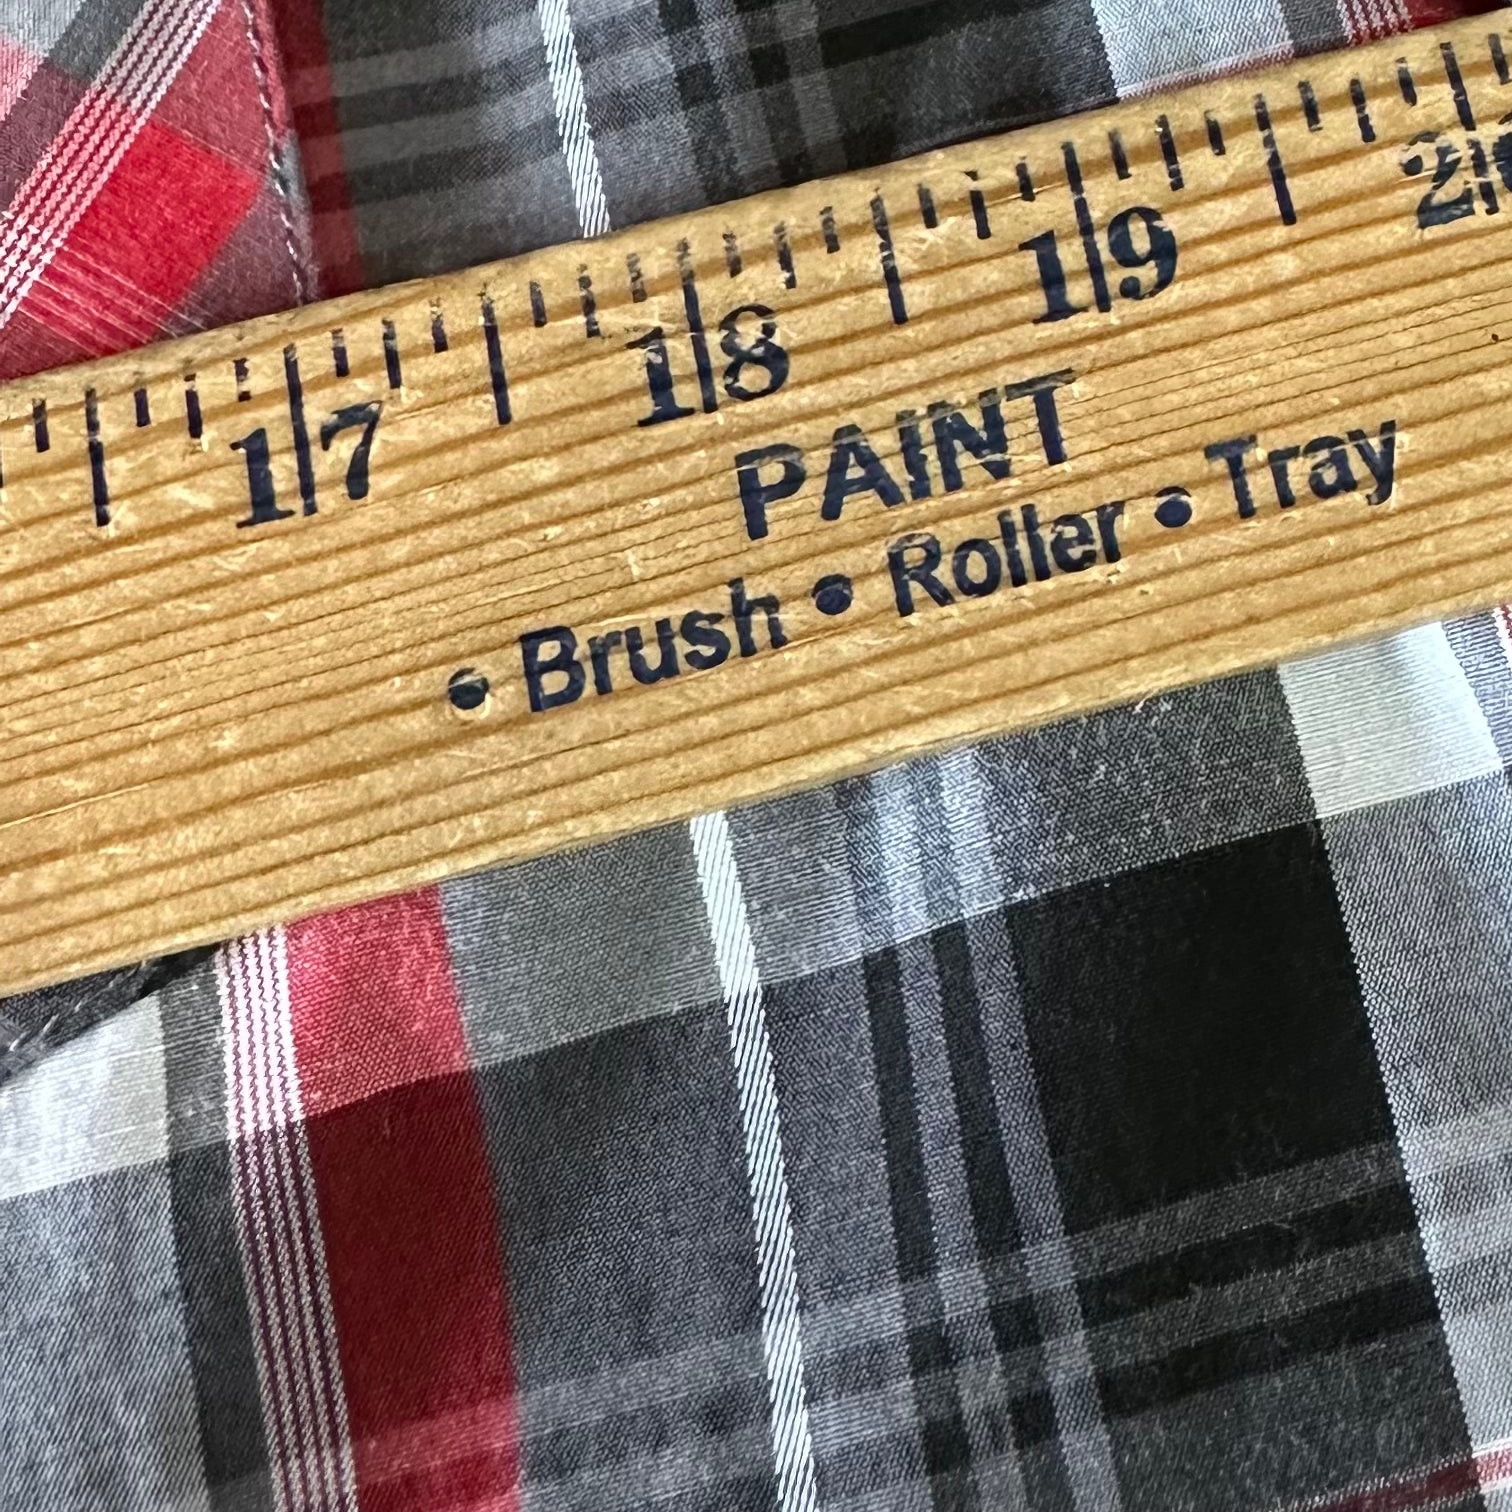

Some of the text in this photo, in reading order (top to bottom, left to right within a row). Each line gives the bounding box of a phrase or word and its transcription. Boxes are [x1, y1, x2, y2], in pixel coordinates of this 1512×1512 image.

[231, 399, 383, 528] 17
[628, 304, 791, 427] 18
[1019, 205, 1178, 324] 19
[735, 367, 1080, 540] PAINT
[520, 419, 1397, 712] Brush Roller Tray
